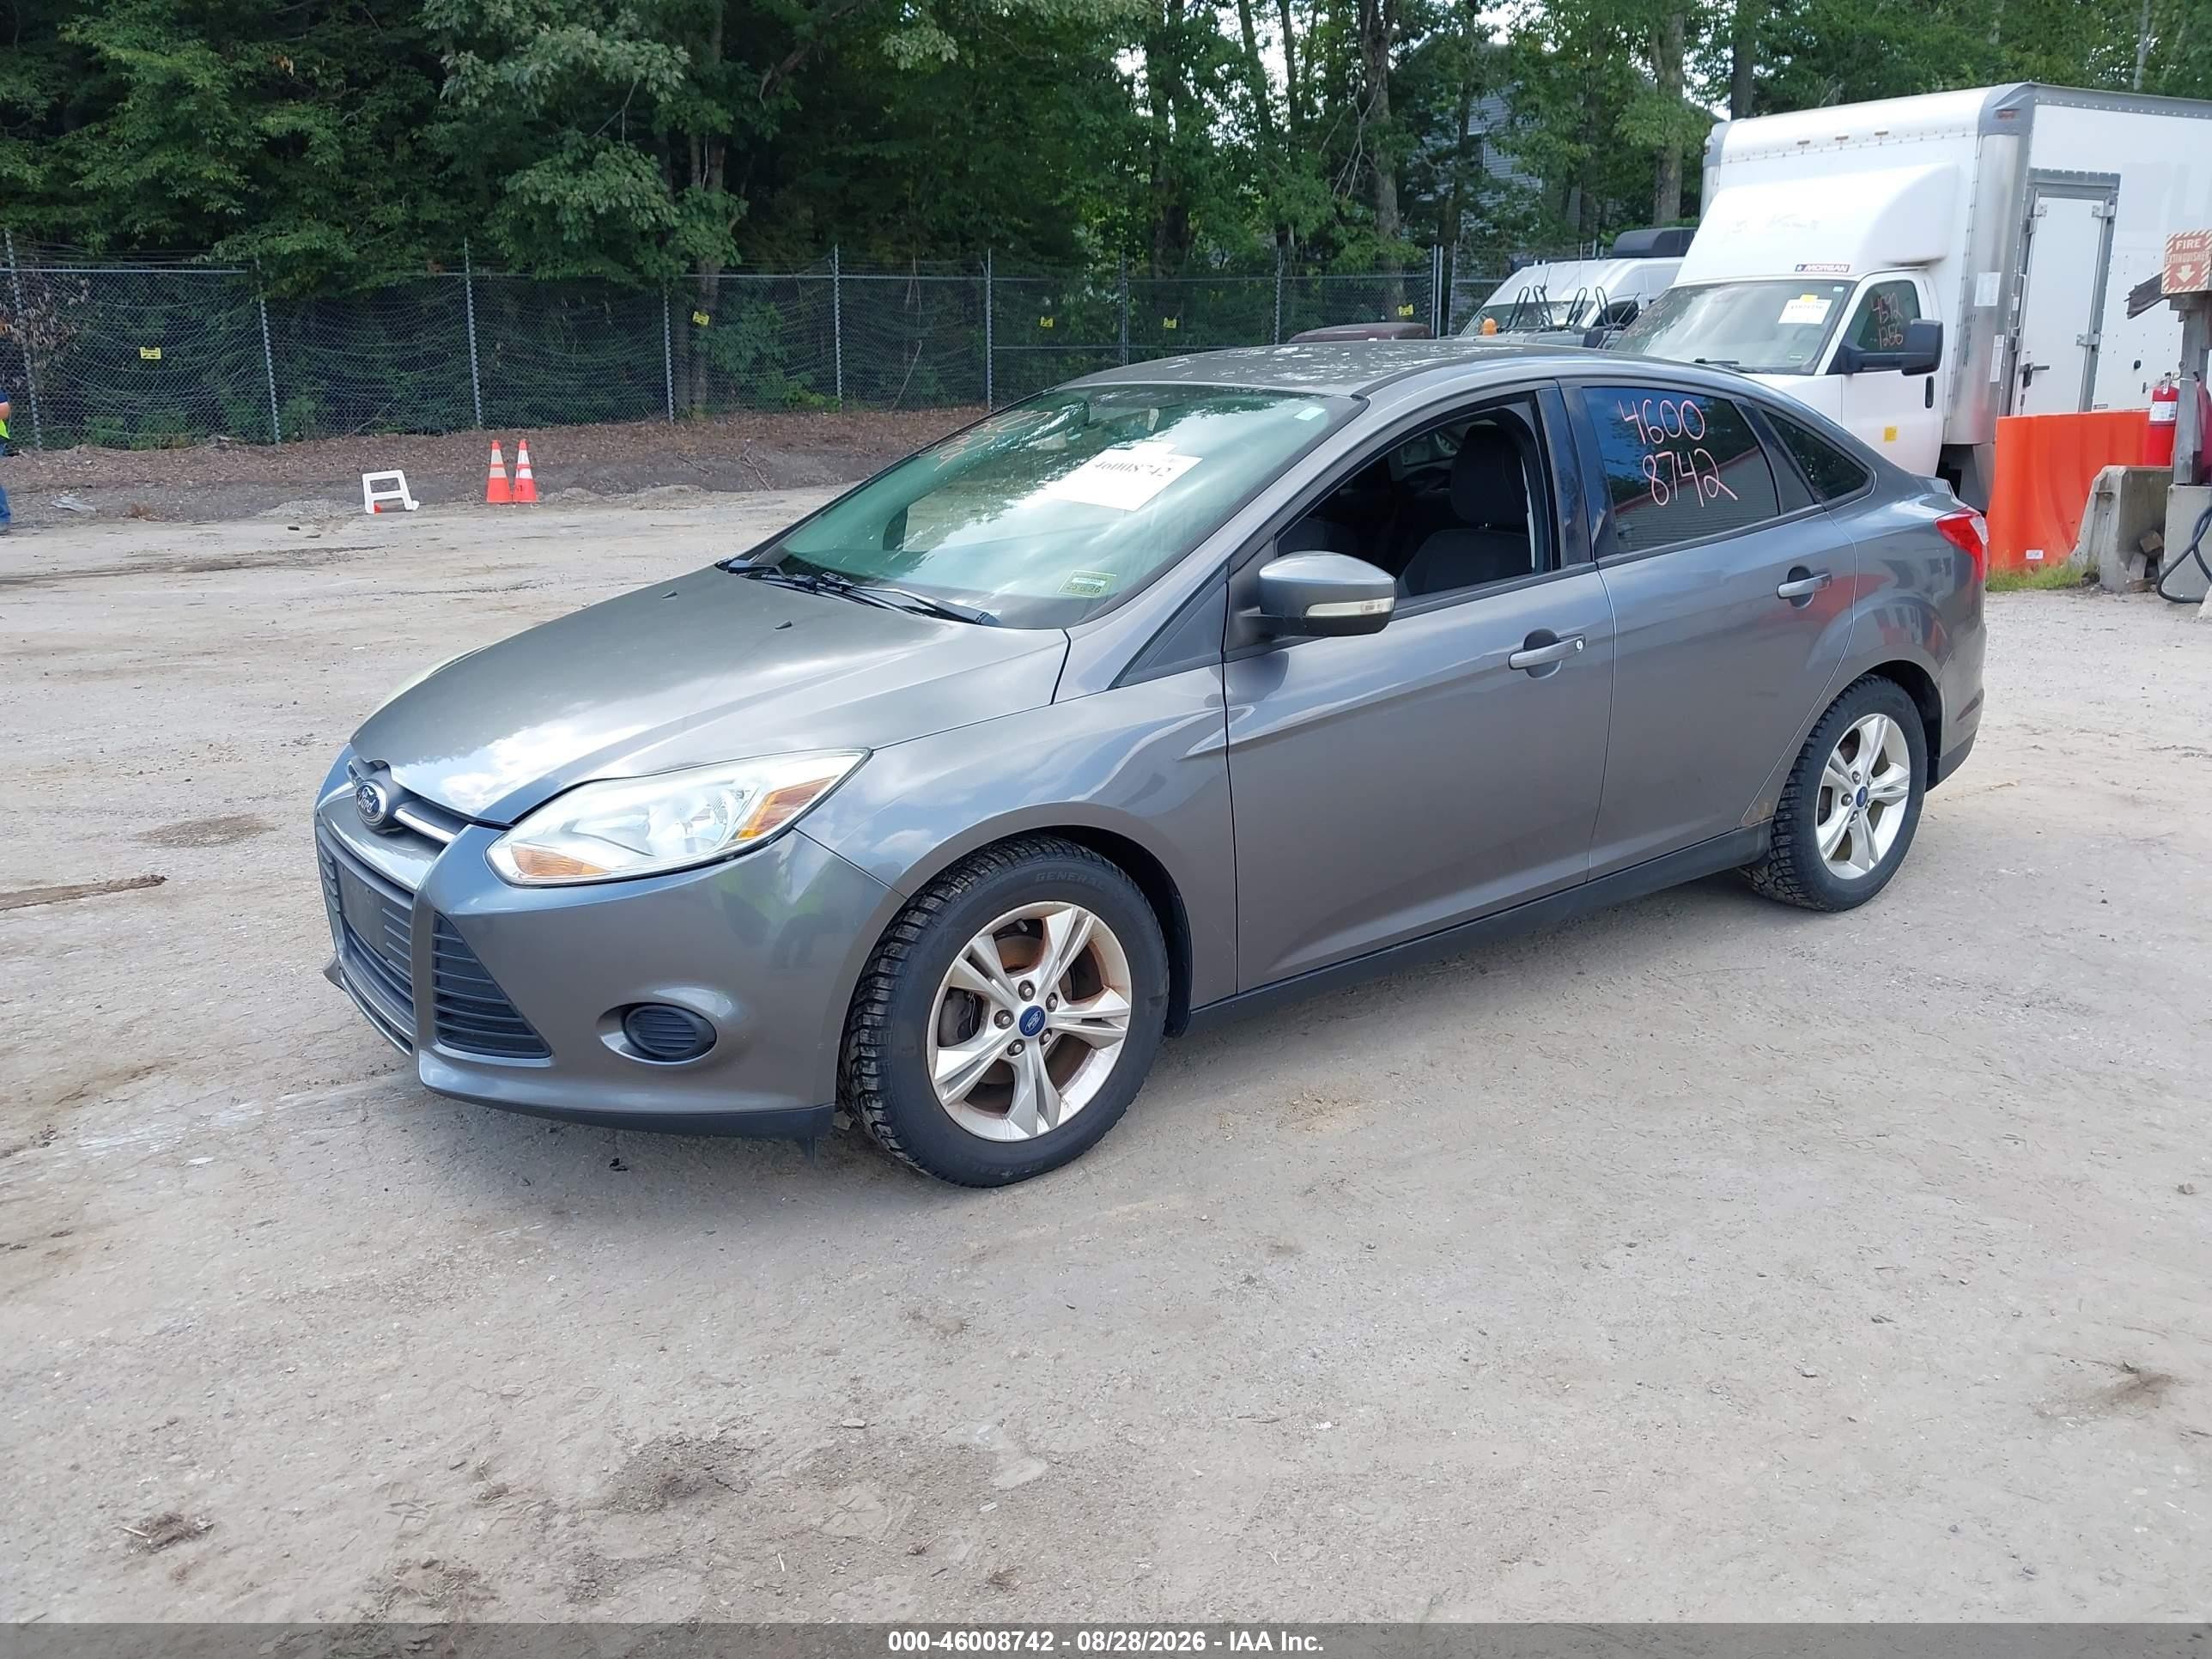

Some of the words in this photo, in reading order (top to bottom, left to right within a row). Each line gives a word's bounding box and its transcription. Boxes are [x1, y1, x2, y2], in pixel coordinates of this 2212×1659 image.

[2176, 238, 2201, 250] FIRE
[2165, 251, 2210, 264] EXTINGUISHER
[1618, 398, 1705, 445] 4600
[1642, 447, 1739, 507] 8742
[357, 786, 377, 813] Ford
[1036, 872, 1104, 890] GENERAL
